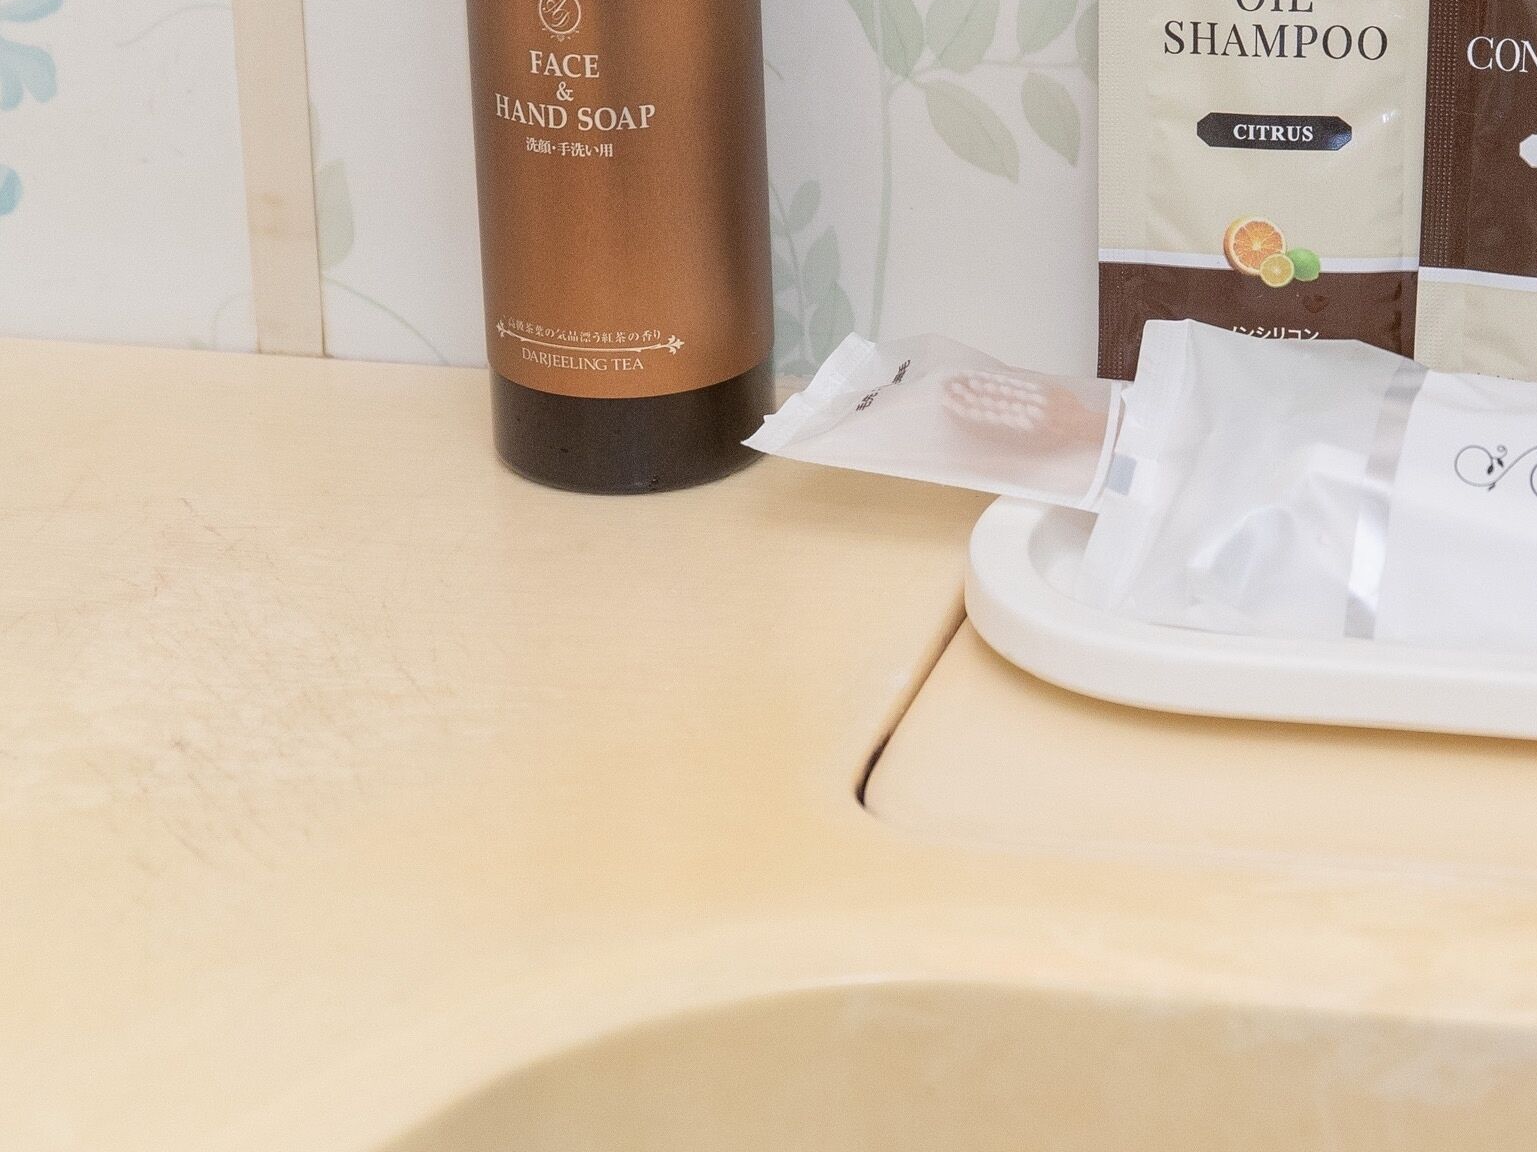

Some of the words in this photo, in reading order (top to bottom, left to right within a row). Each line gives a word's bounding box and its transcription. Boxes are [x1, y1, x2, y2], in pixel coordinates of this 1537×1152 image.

[1164, 20, 1389, 61] SHAMPOO
[529, 50, 600, 78] FACE
[556, 81, 574, 101] &
[495, 93, 567, 129] HAND
[577, 104, 656, 131] SOAP
[1233, 123, 1314, 143] CITRUS
[521, 348, 607, 371] DARJEELING
[611, 358, 644, 371] TEA
